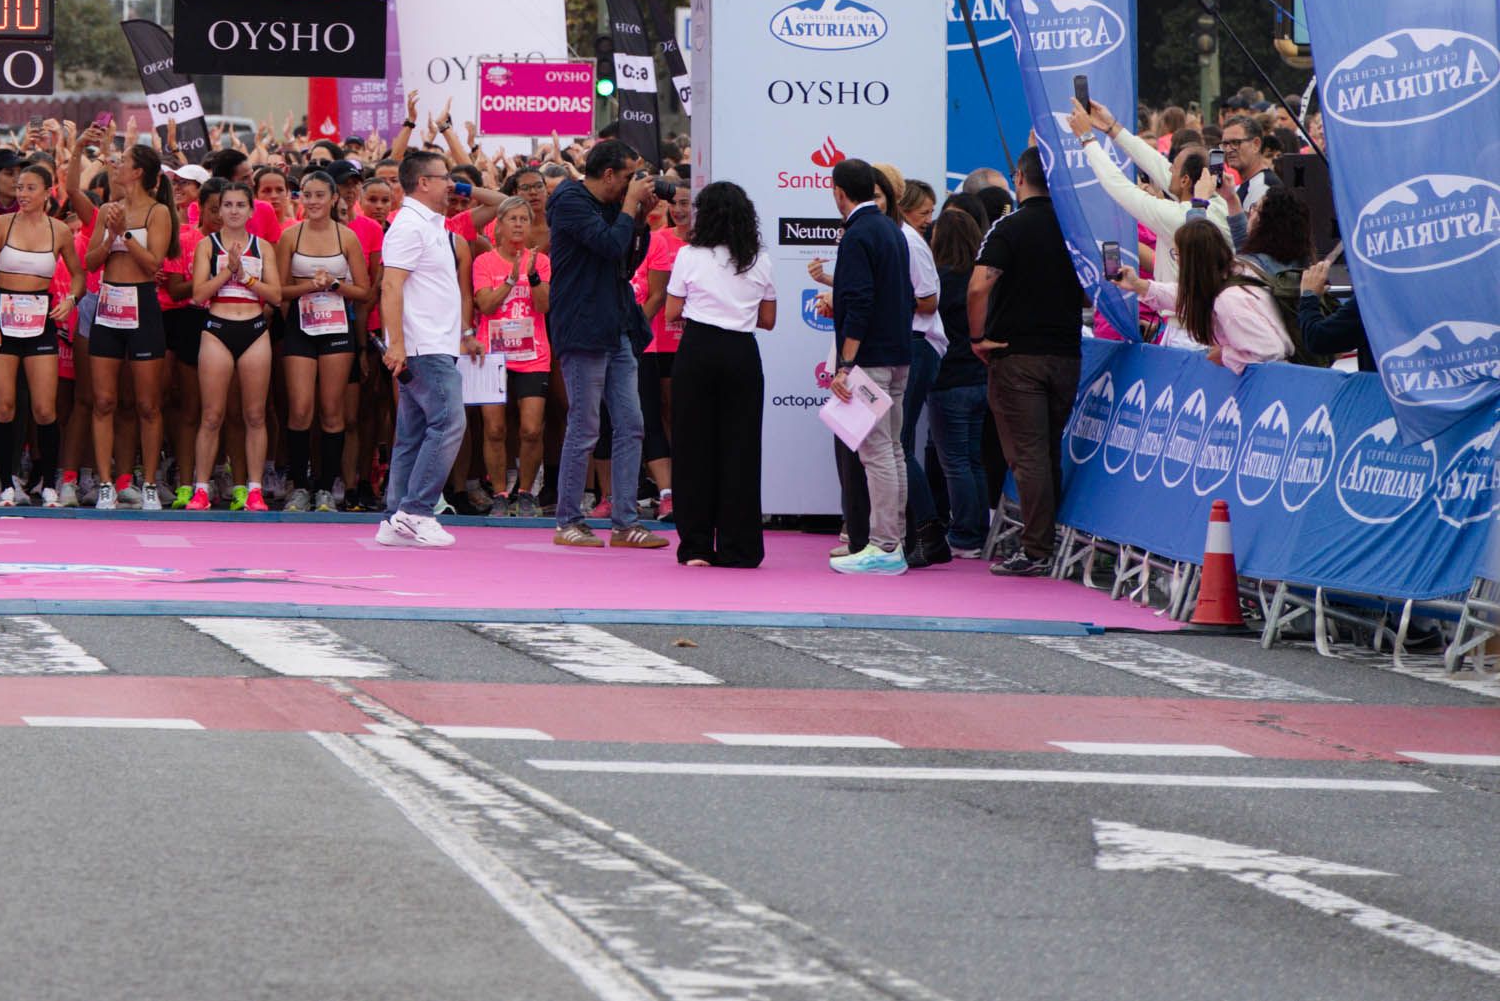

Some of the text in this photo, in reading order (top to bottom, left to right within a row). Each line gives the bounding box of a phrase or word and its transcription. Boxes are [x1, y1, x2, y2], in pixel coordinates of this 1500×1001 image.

[208, 19, 356, 53] OYSHO
[779, 15, 879, 38] ASTURIANA
[545, 71, 591, 82] OYSHO
[481, 94, 592, 113] CORREDORAS
[768, 79, 890, 105] OYSHO
[1341, 450, 1427, 500] ASTURIANA
